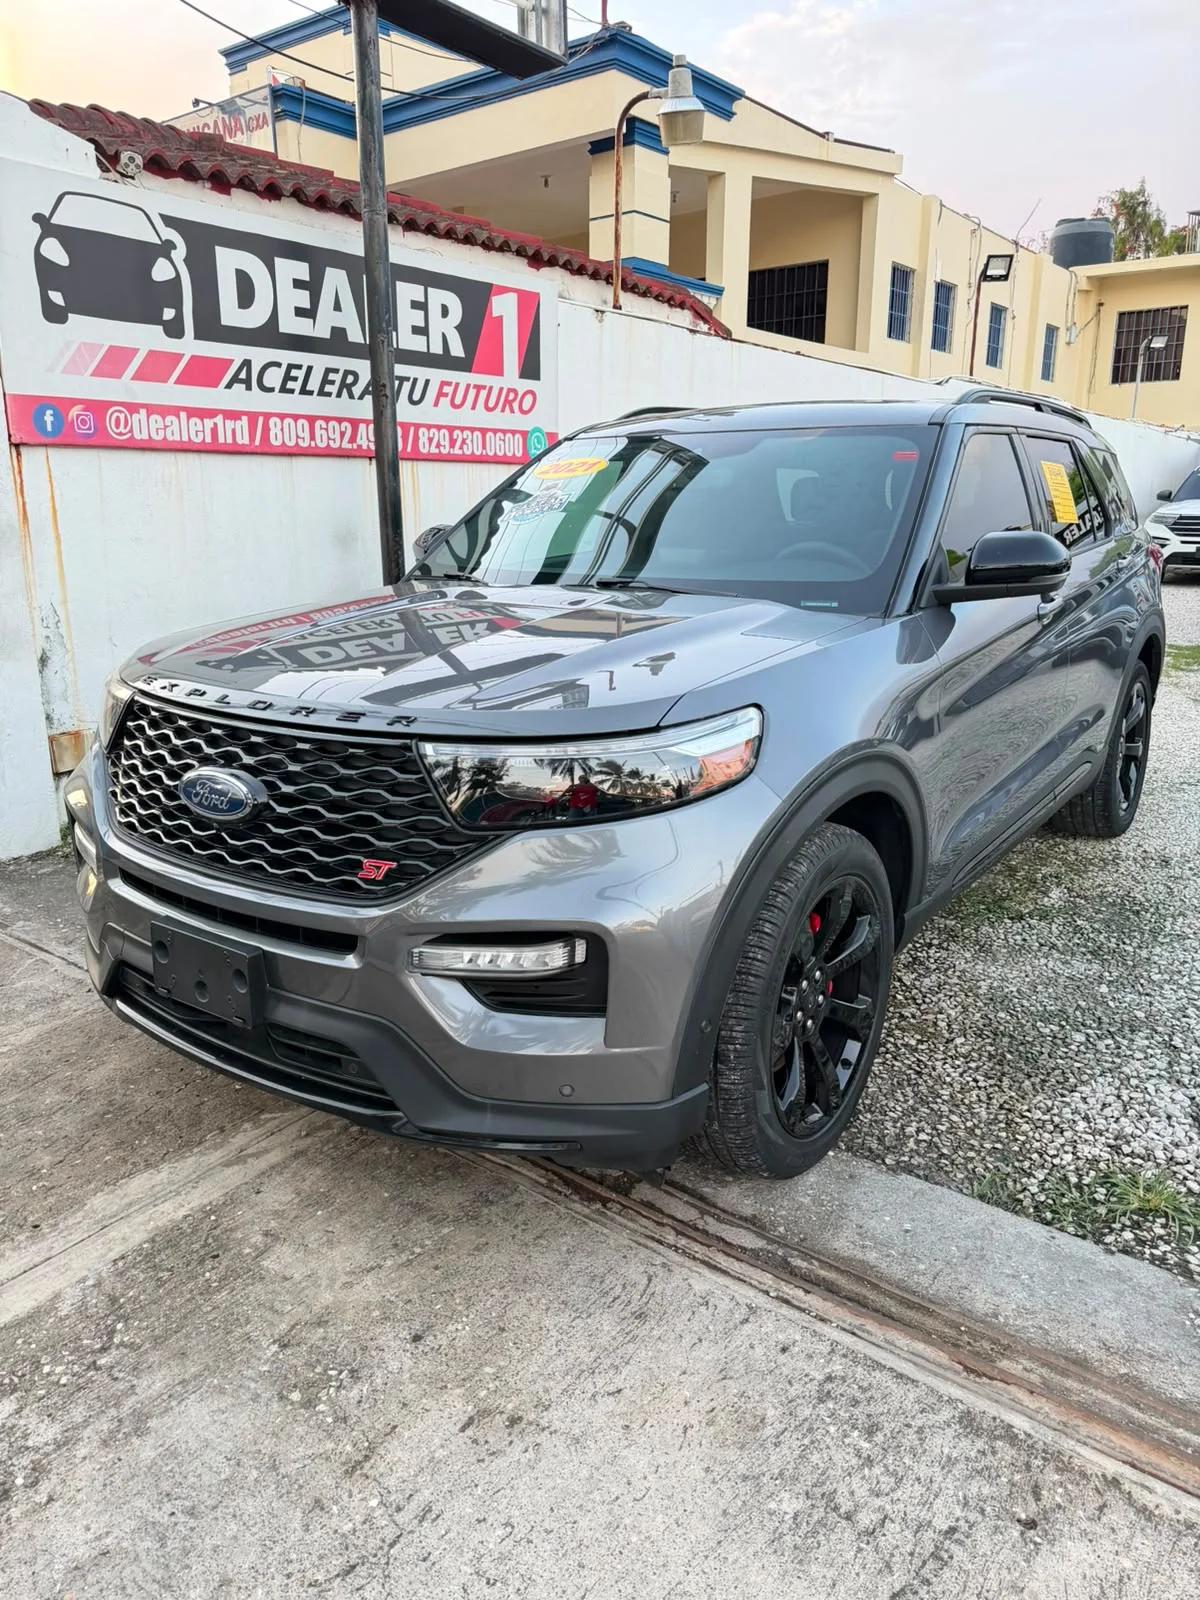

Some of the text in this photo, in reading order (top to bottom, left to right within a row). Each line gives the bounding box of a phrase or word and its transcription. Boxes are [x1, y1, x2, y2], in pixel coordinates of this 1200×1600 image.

[214, 245, 520, 379] DEAER 1
[433, 380, 537, 416] FUTURO
[106, 406, 250, 446] @dealer1rd
[418, 428, 523, 457] 829.230.0600
[141, 675, 417, 727] EXPLORER
[191, 780, 233, 809] Ford
[357, 859, 398, 880] ST
